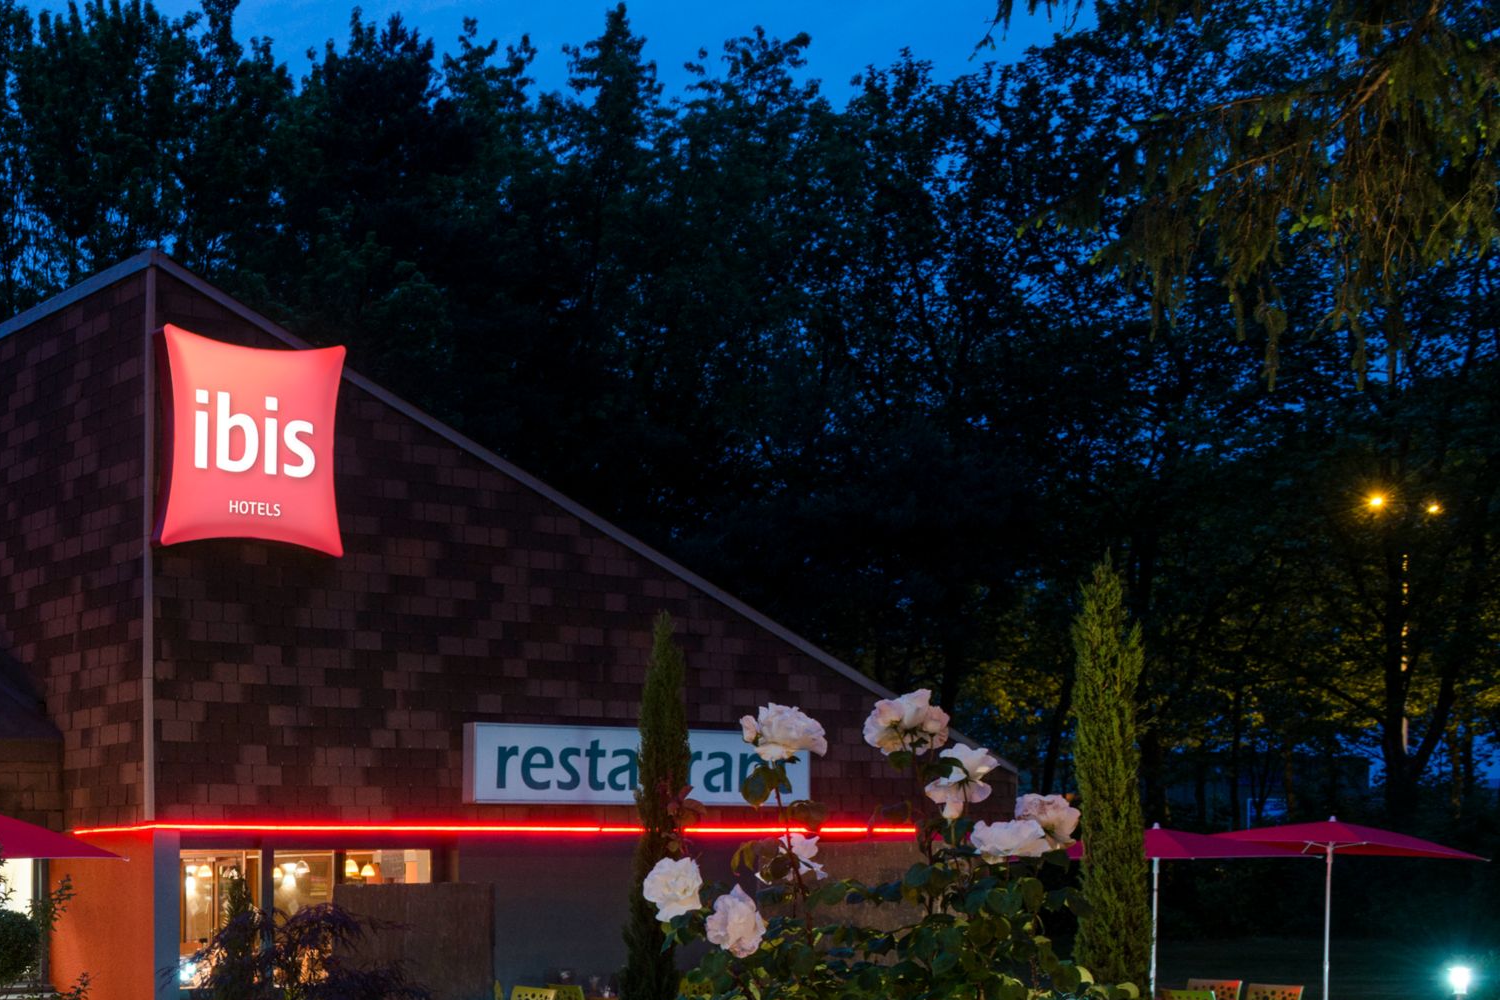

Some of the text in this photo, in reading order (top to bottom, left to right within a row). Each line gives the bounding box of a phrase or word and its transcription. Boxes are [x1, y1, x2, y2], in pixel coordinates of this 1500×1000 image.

[194, 389, 316, 478] ibis
[229, 500, 281, 517] HOTELS
[496, 739, 792, 793] restara
